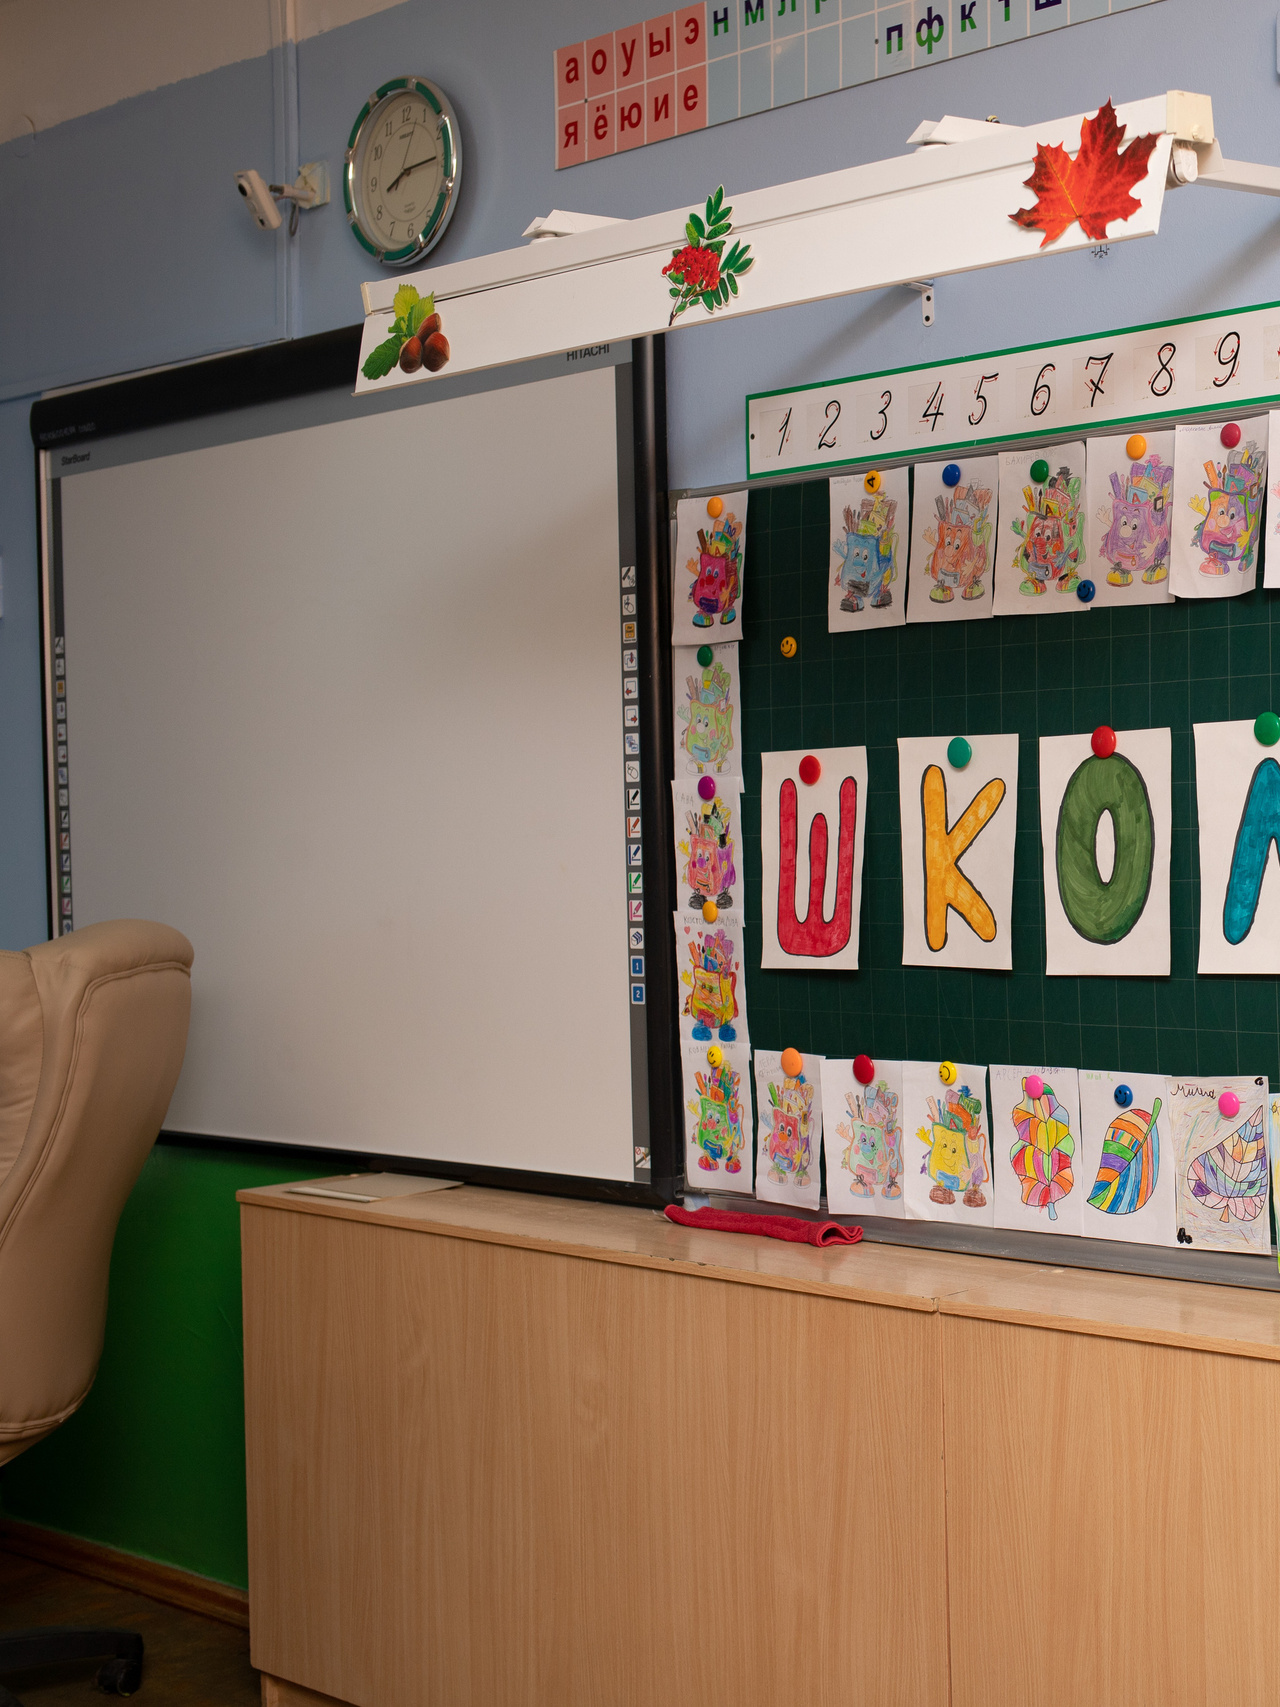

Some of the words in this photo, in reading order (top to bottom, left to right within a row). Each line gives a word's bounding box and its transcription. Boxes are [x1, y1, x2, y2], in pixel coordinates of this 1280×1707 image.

[565, 57, 579, 84] а
[591, 48, 607, 75] о
[621, 38, 636, 77] у
[649, 27, 671, 58] ы
[684, 17, 699, 45] э
[713, 7, 729, 37] н
[745, 0, 764, 26] м
[563, 121, 578, 148] я
[594, 105, 608, 140] ё
[620, 102, 642, 132] ю
[654, 94, 669, 122] и
[683, 84, 698, 111] е
[886, 23, 903, 55] п
[915, 6, 944, 55] ф
[961, 1, 977, 33] к
[402, 105, 412, 124] 12
[385, 122, 393, 137] 11
[373, 144, 382, 162] 10
[370, 176, 378, 193] 9
[376, 204, 383, 221] 8
[389, 221, 395, 238] 7
[407, 222, 414, 239] 6
[566, 343, 610, 362] HITACHI
[778, 407, 792, 456] 1
[818, 400, 841, 450] 2
[870, 390, 892, 440] 3
[922, 381, 944, 432] 4
[968, 372, 999, 426] 5
[1030, 363, 1056, 415] 6
[1085, 352, 1114, 407] 7
[1151, 342, 1176, 396] 8
[1213, 331, 1240, 387] 9
[61, 451, 91, 467] StarBoard
